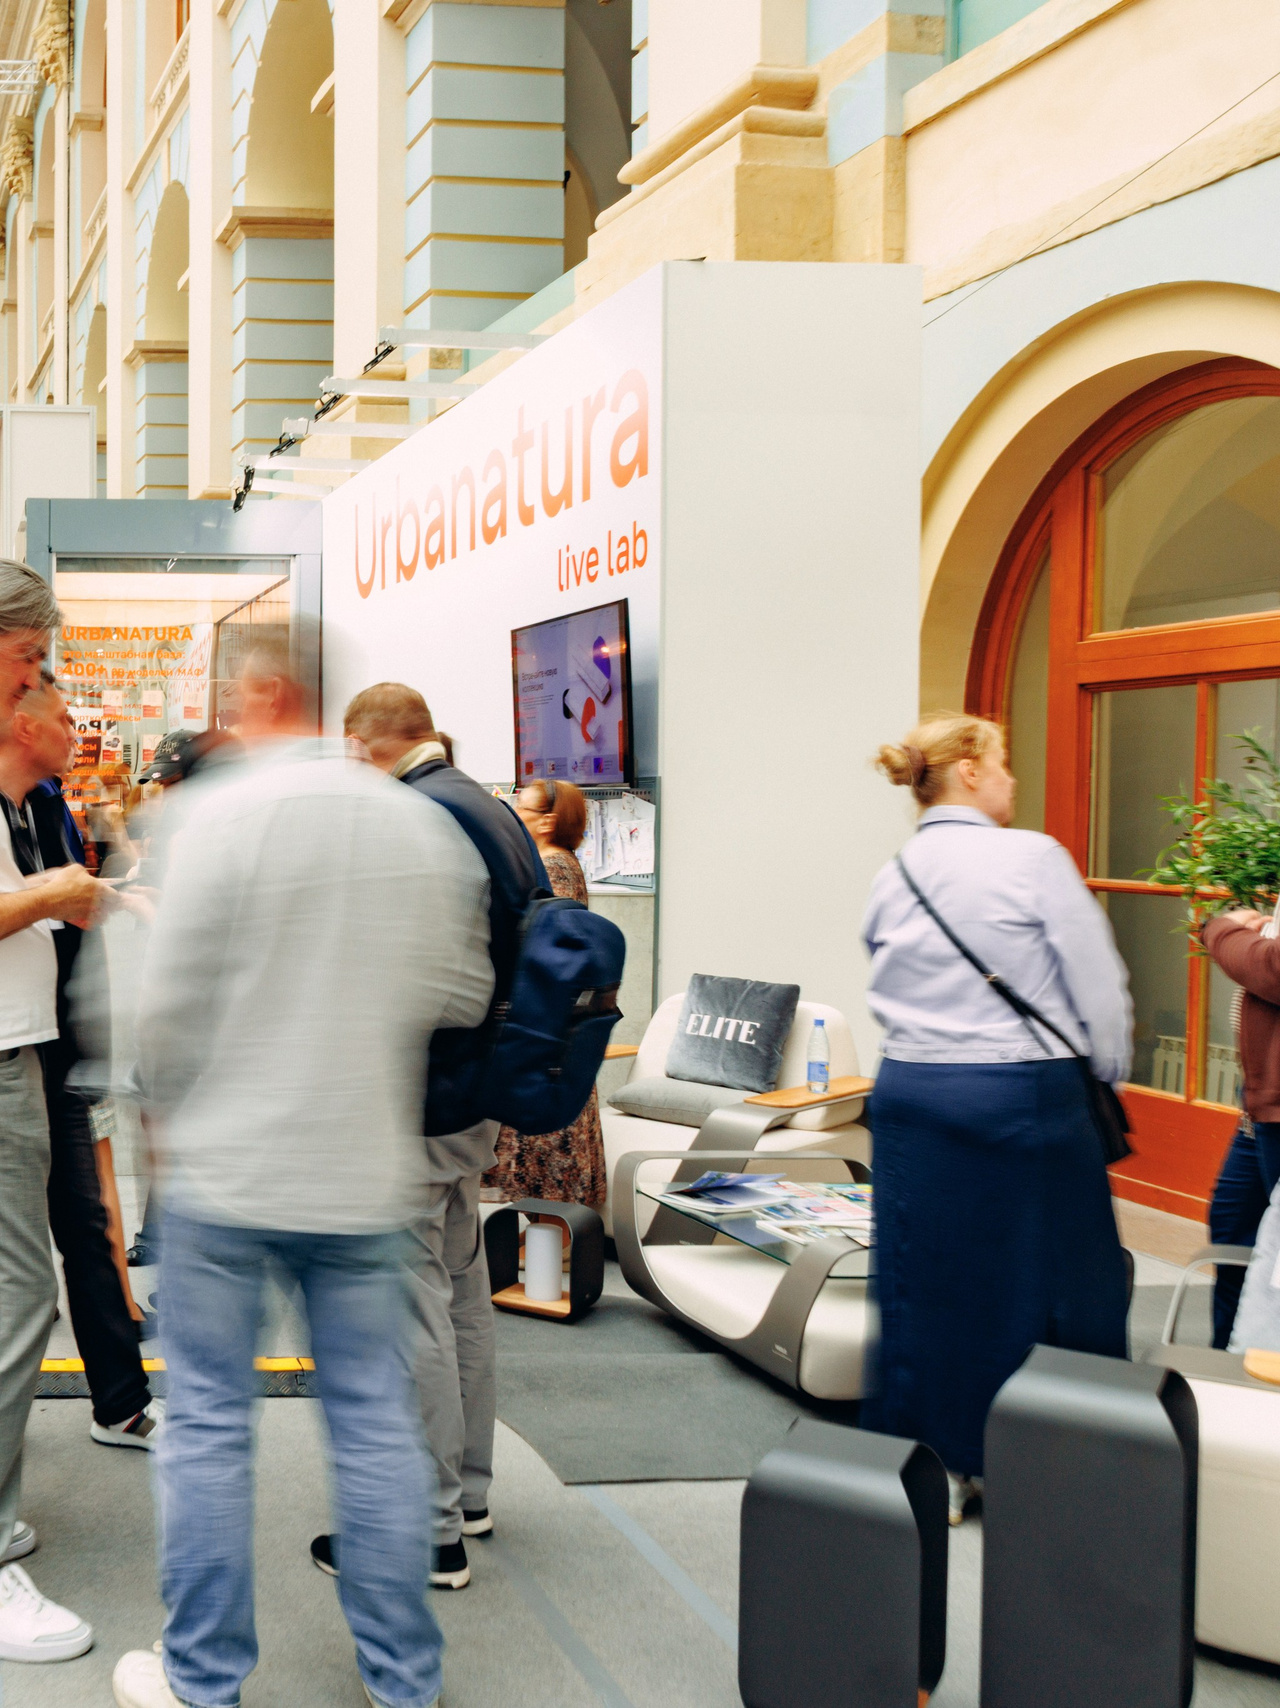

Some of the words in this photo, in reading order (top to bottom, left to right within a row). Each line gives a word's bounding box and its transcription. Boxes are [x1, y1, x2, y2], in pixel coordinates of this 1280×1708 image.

[354, 368, 649, 600] Urbanatura
[557, 544, 600, 592] live
[606, 520, 649, 577] lab
[61, 626, 194, 641] URBANATURA
[61, 661, 106, 677] 400+
[685, 1013, 761, 1045] ELITE
